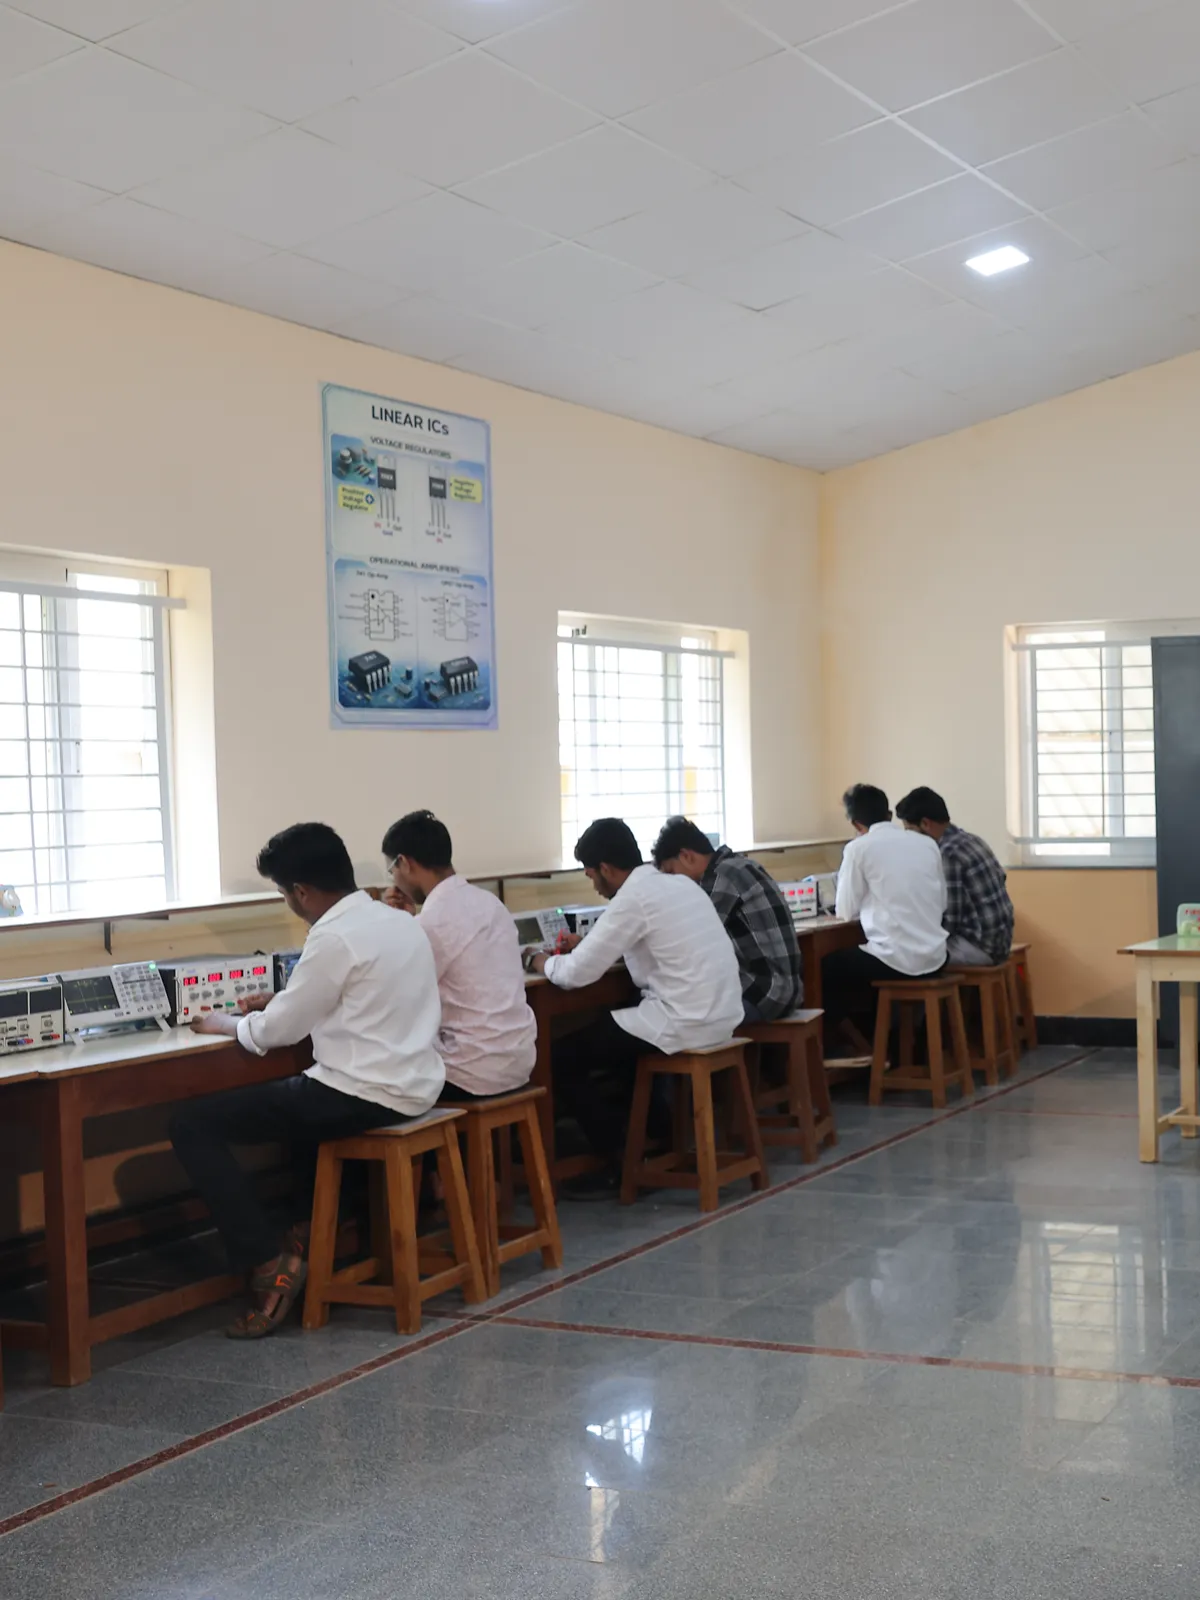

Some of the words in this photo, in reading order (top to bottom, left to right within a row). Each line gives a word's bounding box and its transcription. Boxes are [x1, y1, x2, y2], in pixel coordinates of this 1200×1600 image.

[371, 405, 423, 430] LINEAR
[427, 418, 449, 435] ICs
[370, 436, 403, 450] VOLTAGE
[404, 443, 452, 460] REGULATORS
[369, 556, 418, 570] OPERATIONAL
[420, 561, 461, 575] AMPLIFIERS
